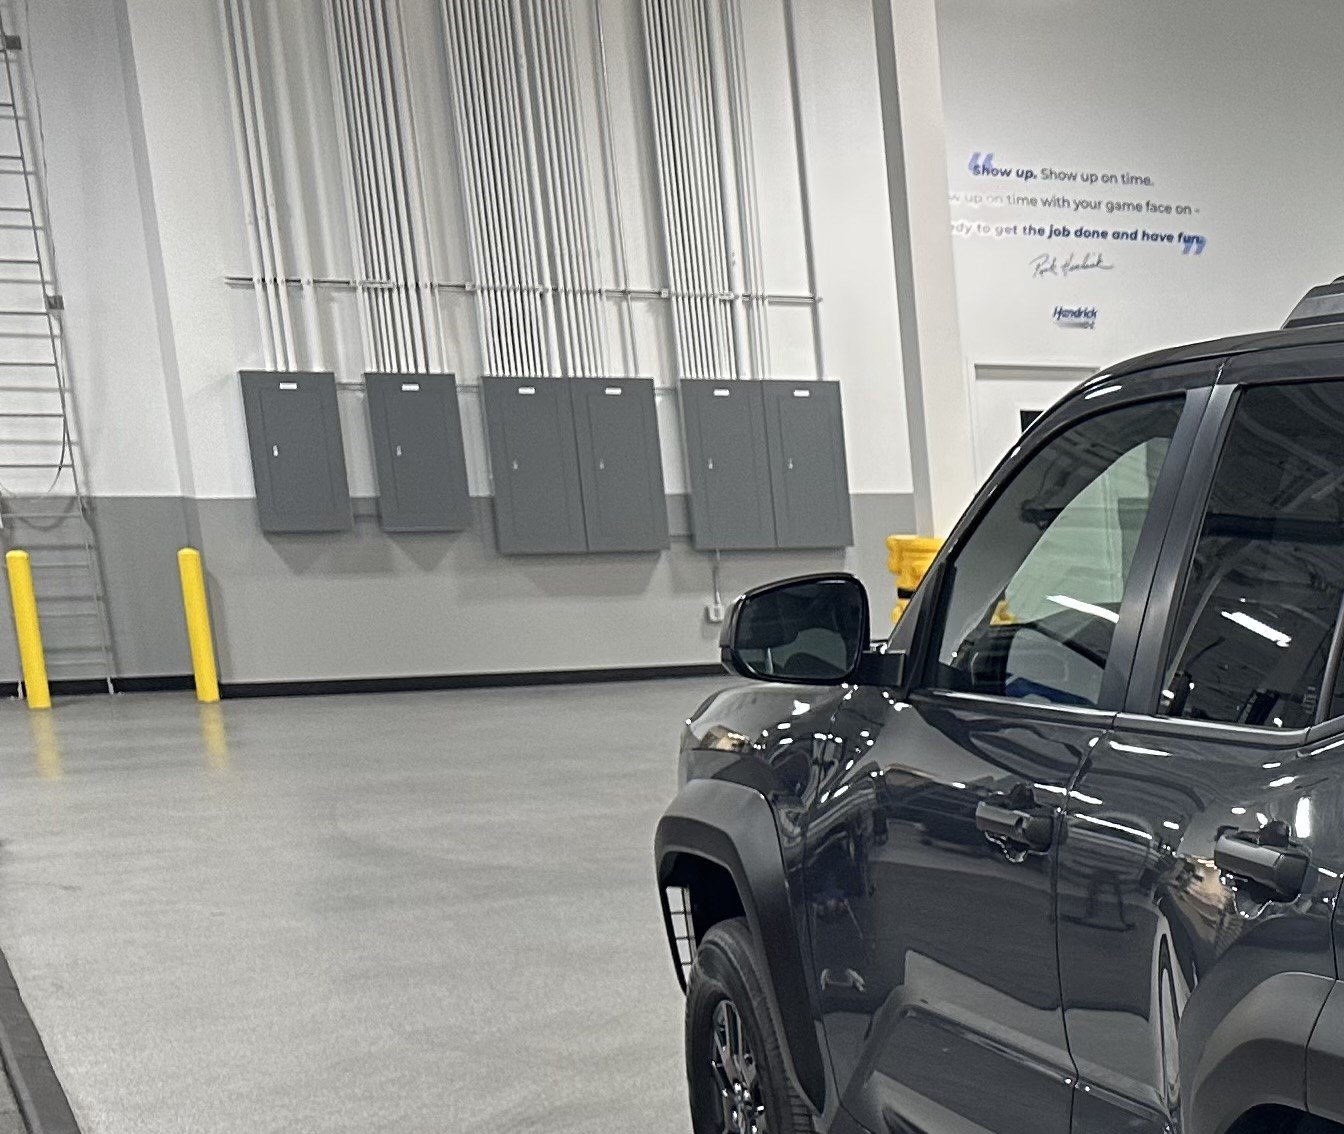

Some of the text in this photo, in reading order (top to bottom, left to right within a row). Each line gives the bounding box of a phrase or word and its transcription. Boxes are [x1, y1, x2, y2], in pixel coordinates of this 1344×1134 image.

[1041, 168, 1077, 181] Show
[1080, 172, 1099, 184] up
[1101, 173, 1118, 184] on
[1007, 193, 1038, 207] time
[1041, 194, 1071, 208] with
[1073, 199, 1102, 211] your
[1105, 200, 1143, 213] game
[1146, 199, 1172, 214] face
[1175, 205, 1192, 215] on
[995, 224, 1018, 238] get
[1023, 224, 1045, 237] the
[1047, 224, 1071, 239] job
[1074, 226, 1109, 240] done
[1112, 229, 1138, 241] and
[1141, 230, 1175, 243] have
[1052, 306, 1097, 320] Hendrick
